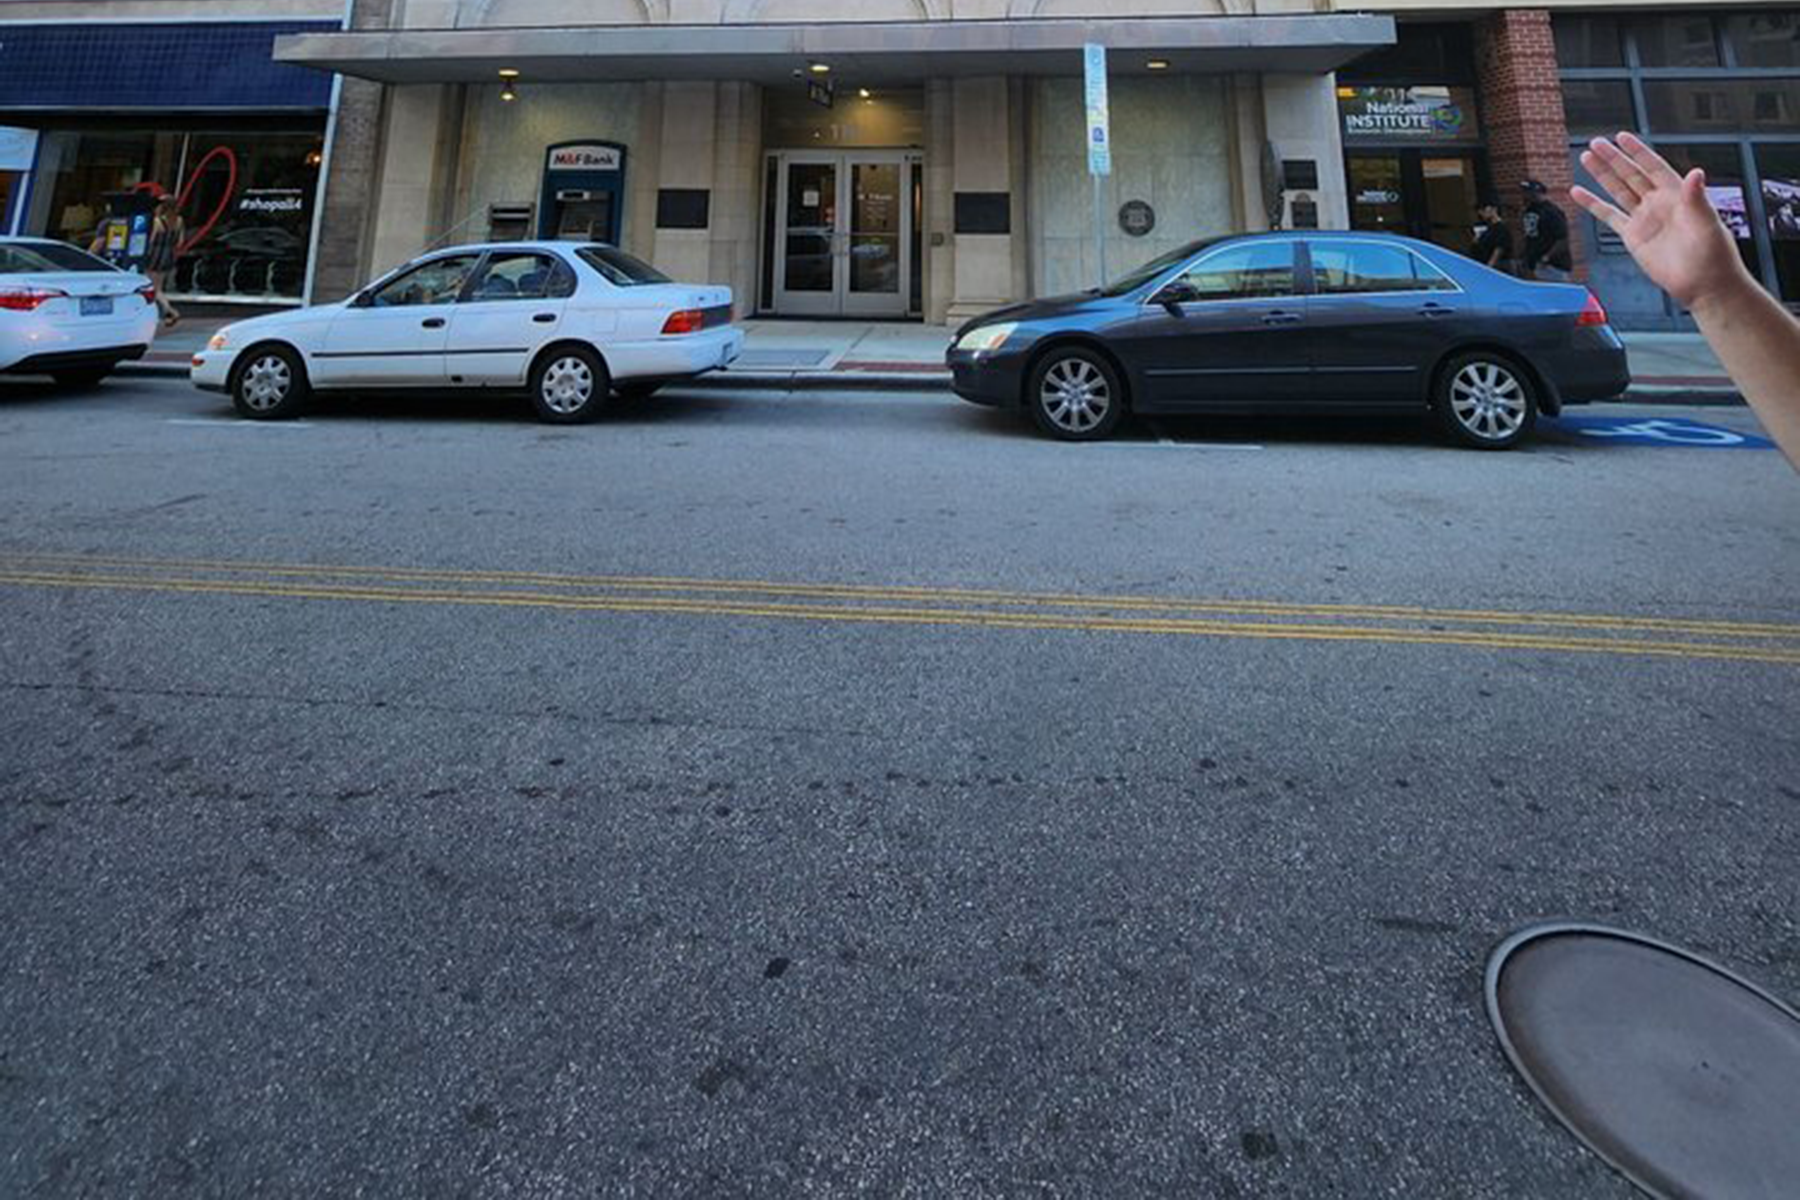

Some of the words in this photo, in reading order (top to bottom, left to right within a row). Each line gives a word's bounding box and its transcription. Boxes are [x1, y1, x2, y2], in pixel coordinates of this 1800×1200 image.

[1366, 101, 1429, 114] National
[1346, 114, 1430, 128] INSTITUTE
[554, 153, 580, 166] M&F
[582, 152, 615, 166] Bank
